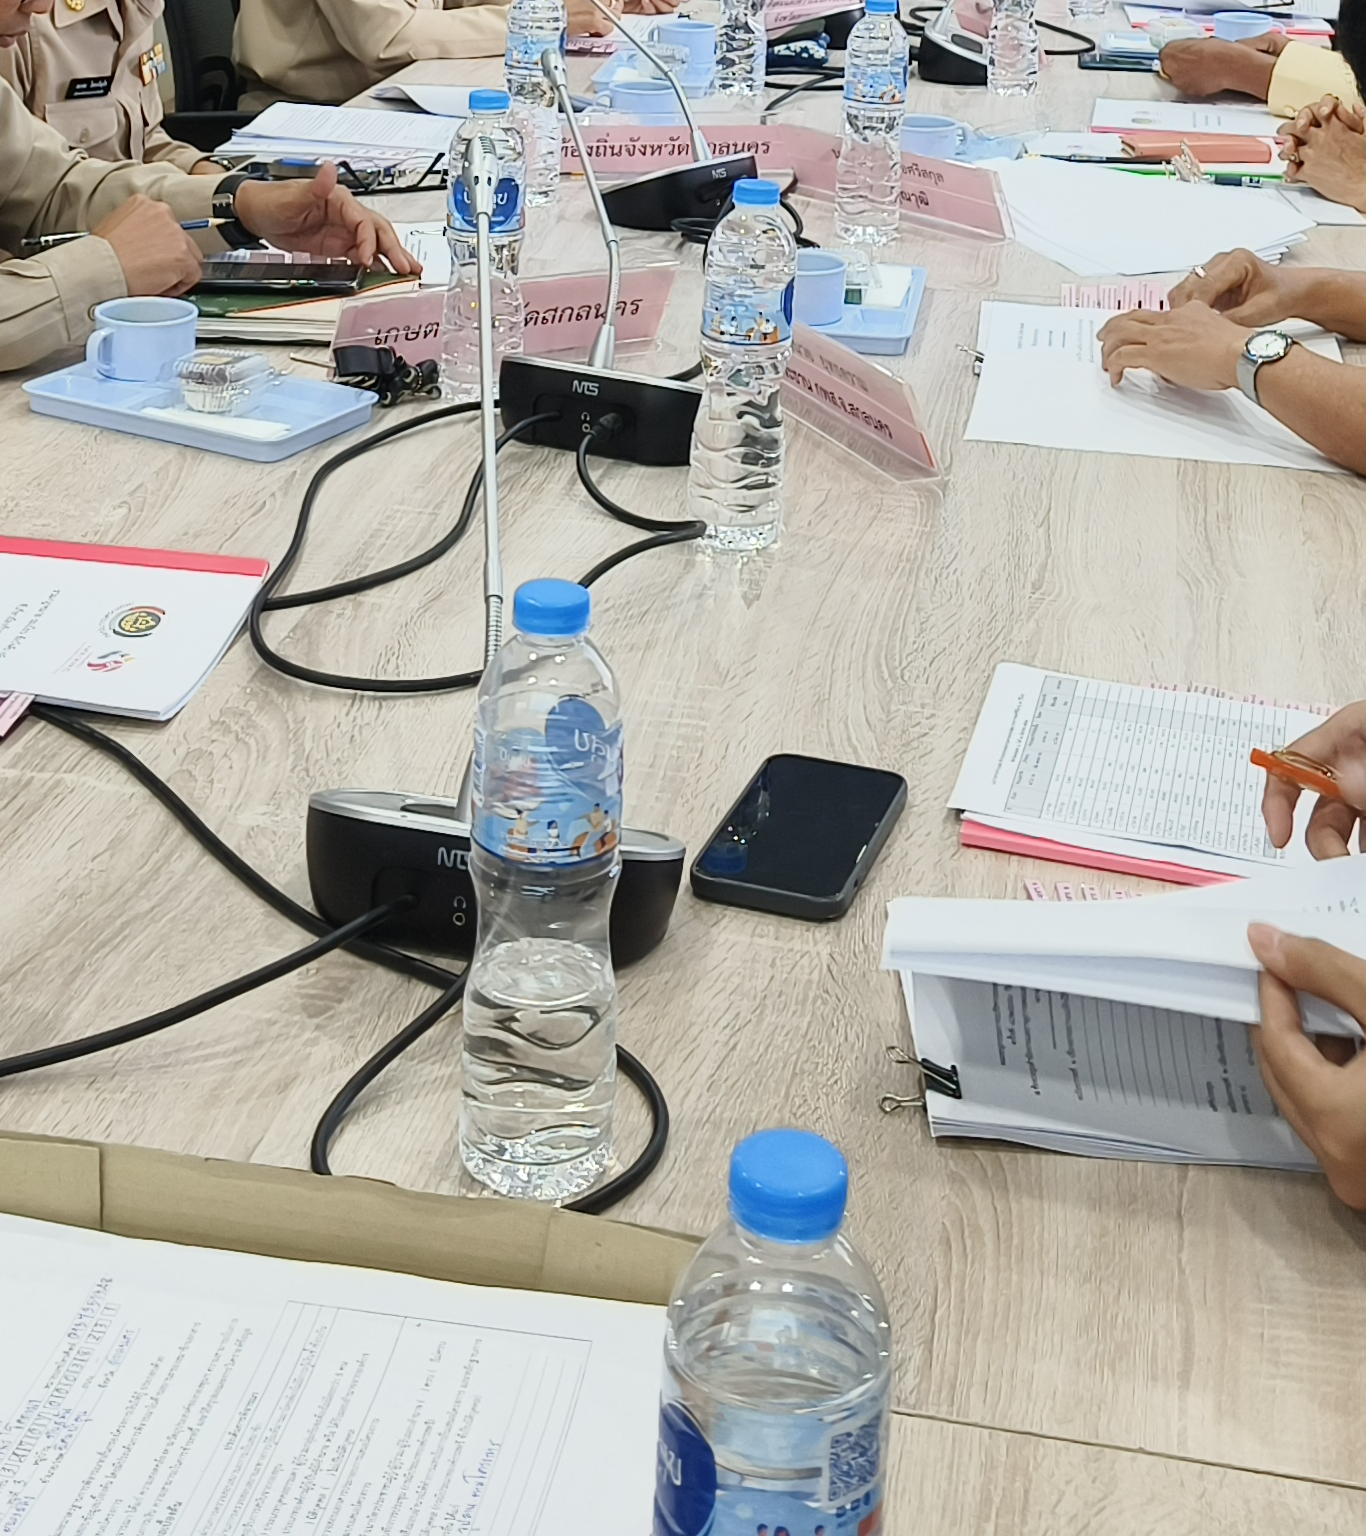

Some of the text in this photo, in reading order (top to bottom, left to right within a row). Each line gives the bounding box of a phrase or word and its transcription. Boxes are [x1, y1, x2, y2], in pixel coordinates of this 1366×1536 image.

[560, 132, 771, 159] ท้องถิ่นจังหวัดกลนคร
